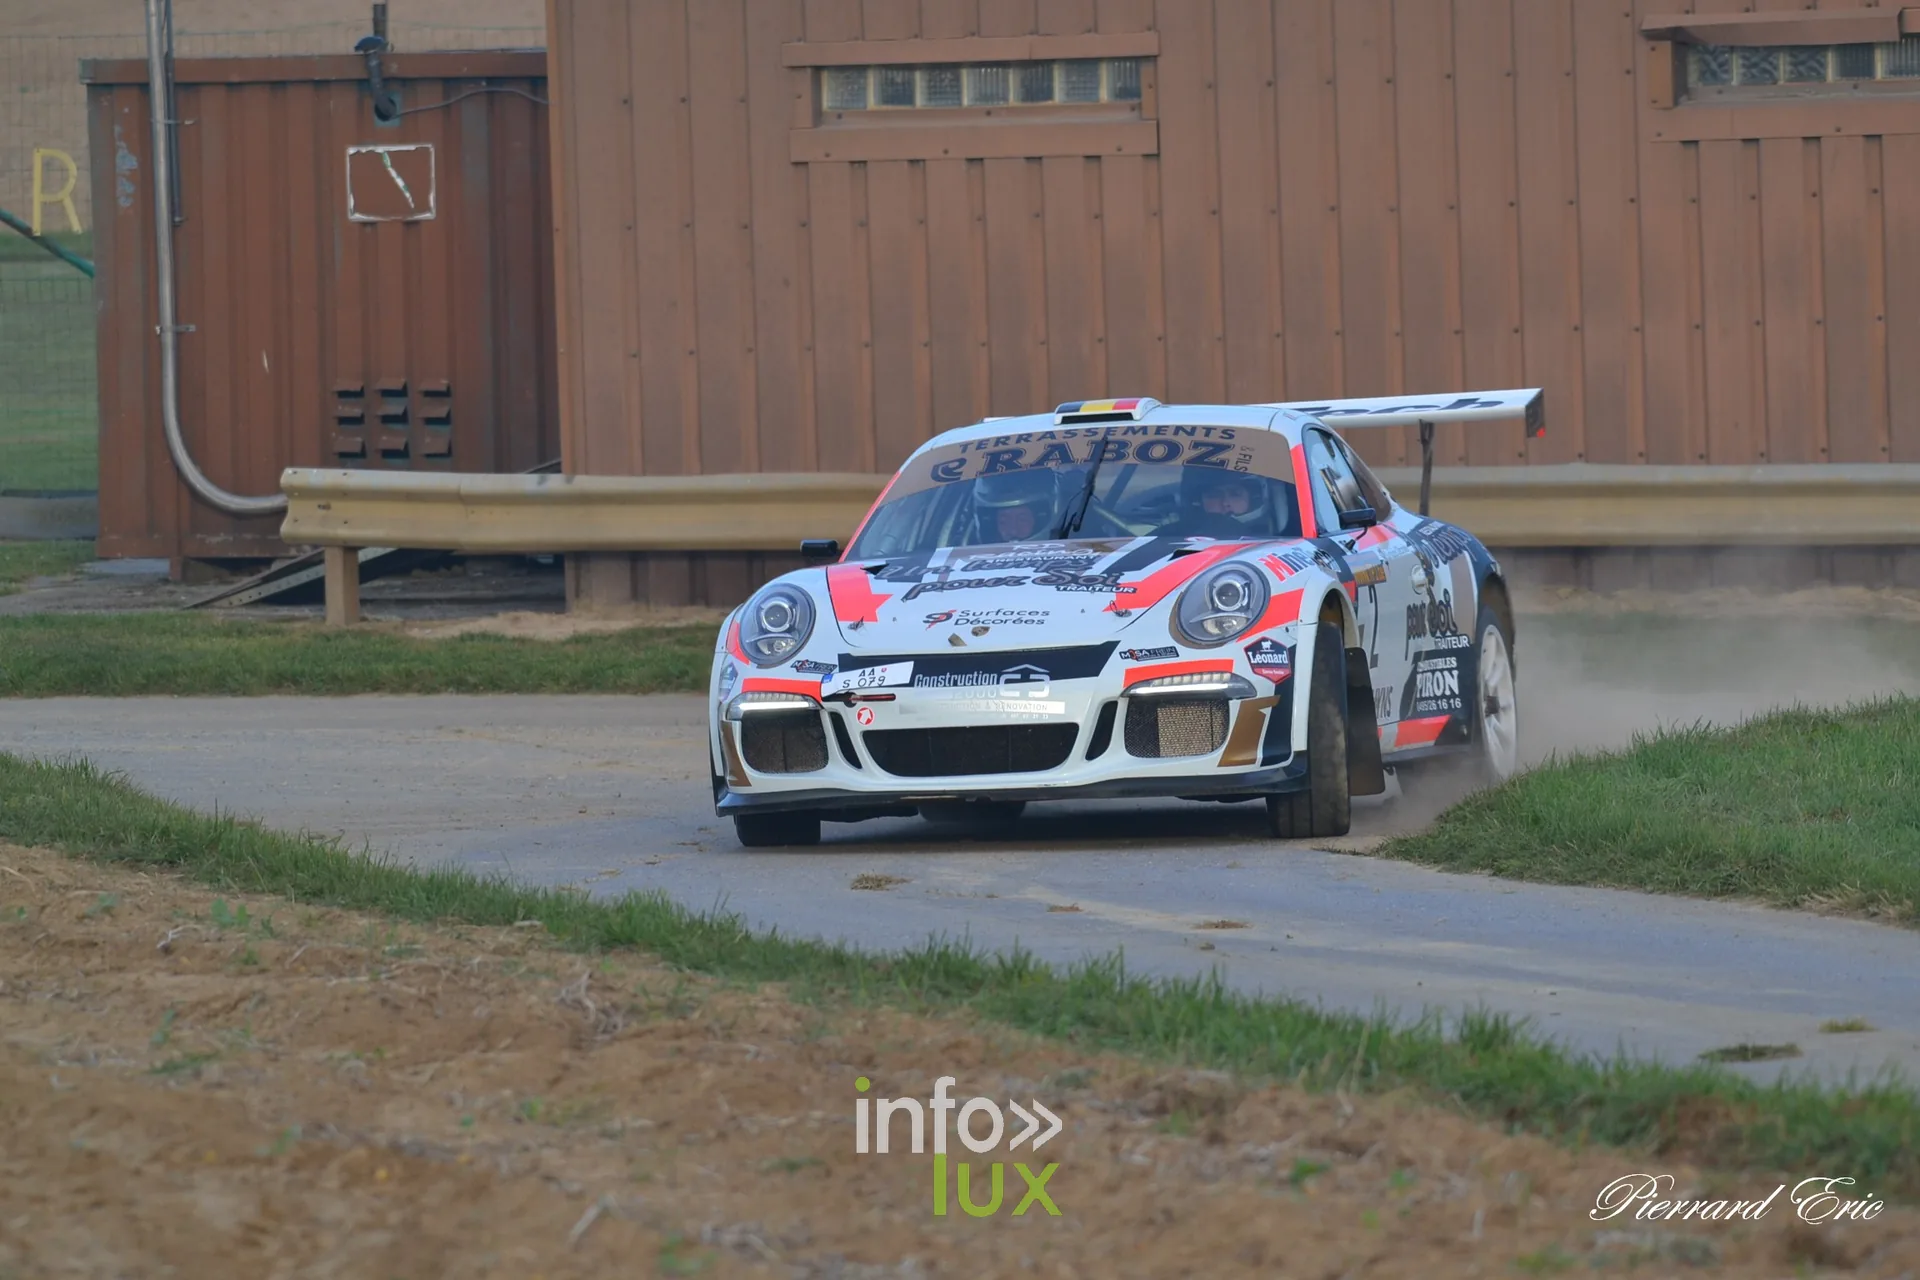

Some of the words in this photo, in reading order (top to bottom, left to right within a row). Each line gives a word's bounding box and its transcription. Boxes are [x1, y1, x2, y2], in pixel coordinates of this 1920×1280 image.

[33, 148, 83, 236] R
[960, 425, 1236, 454] TERRASSEMENTS
[1233, 451, 1252, 472] FILS
[1058, 584, 1136, 594] TRAITEUR
[959, 608, 1051, 617] Surfaces
[955, 616, 1046, 627] Décorées
[858, 668, 875, 677] AA
[914, 670, 998, 688] Construction
[1416, 669, 1460, 699] PIRON
[1438, 699, 1448, 710] 16
[1450, 698, 1462, 709] 16
